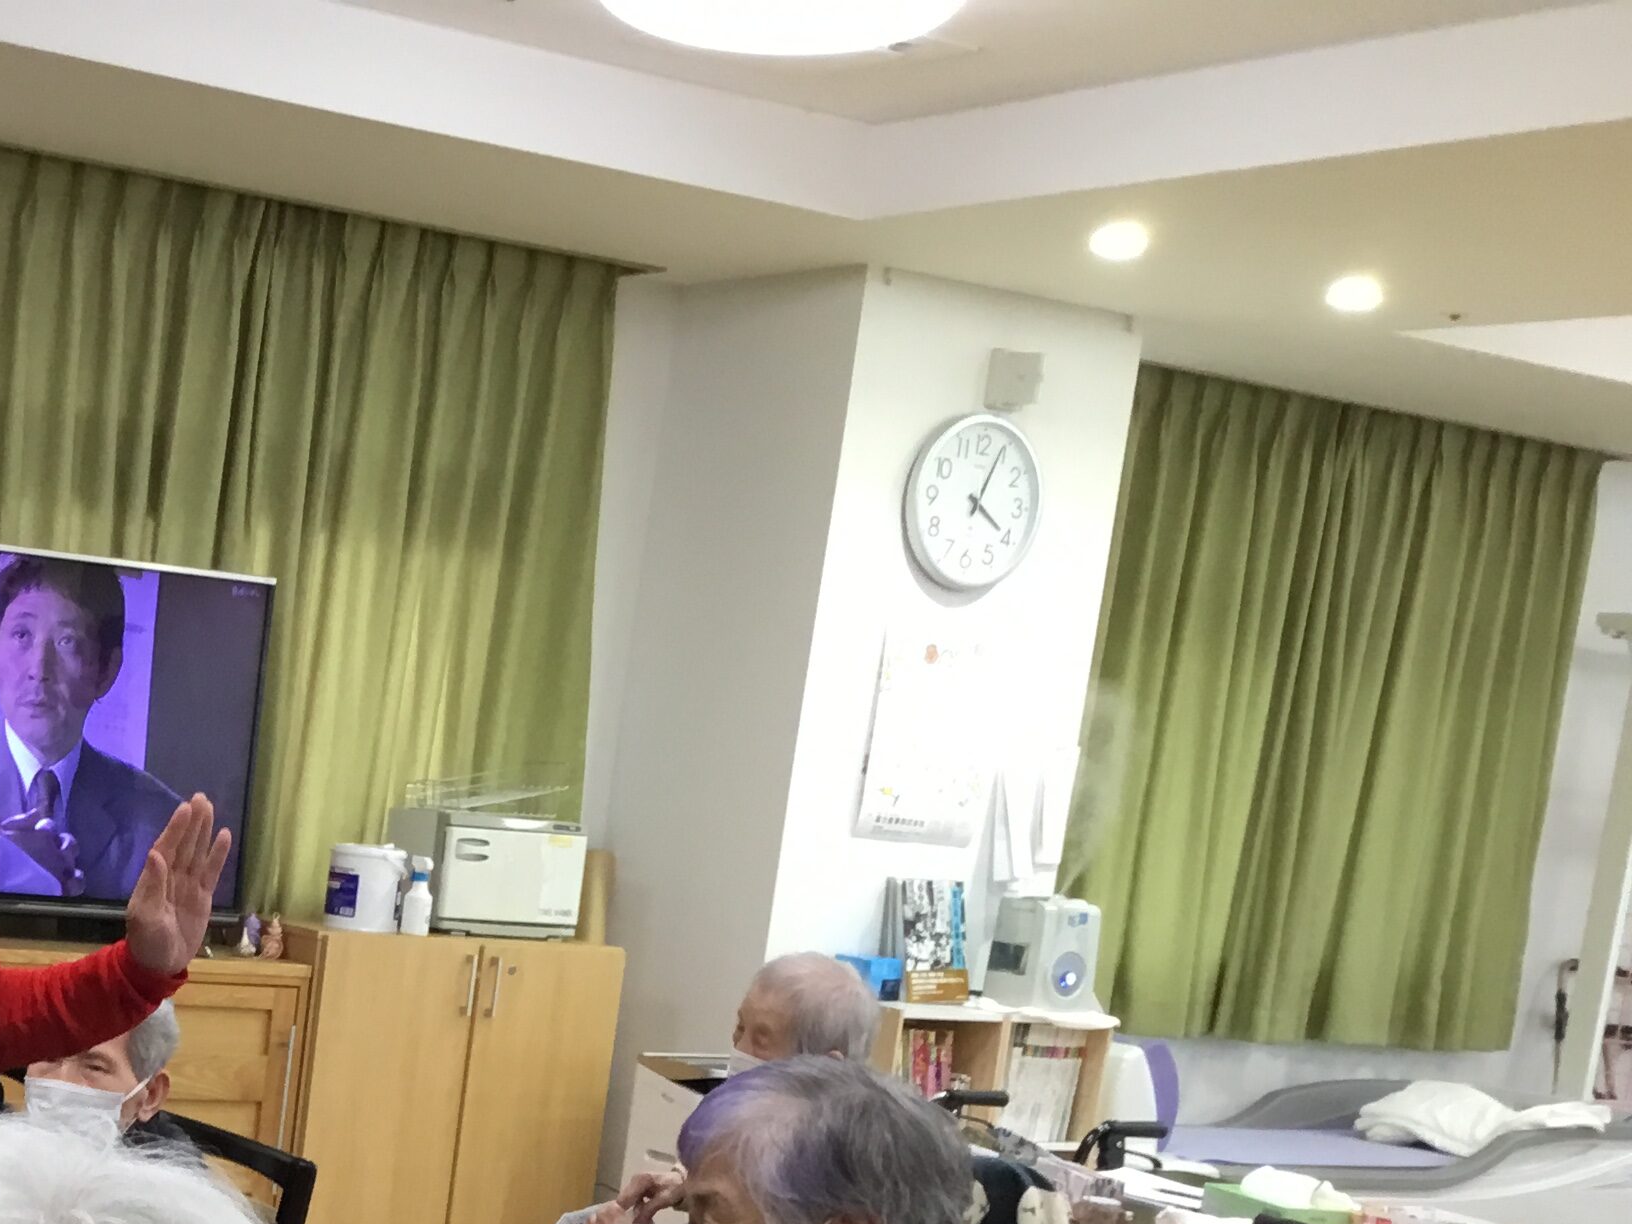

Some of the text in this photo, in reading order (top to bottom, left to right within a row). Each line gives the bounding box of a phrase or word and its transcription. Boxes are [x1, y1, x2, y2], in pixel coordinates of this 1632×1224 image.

[956, 437, 970, 460] 11
[975, 434, 992, 456] 12
[934, 456, 953, 480] 10
[1008, 466, 1021, 488] 2
[926, 484, 939, 506] 9
[1011, 497, 1023, 519] 3
[928, 515, 941, 537] 8
[943, 538, 955, 559] 7
[1000, 528, 1011, 547] 4
[959, 548, 972, 569] 6
[981, 543, 994, 566] 5
